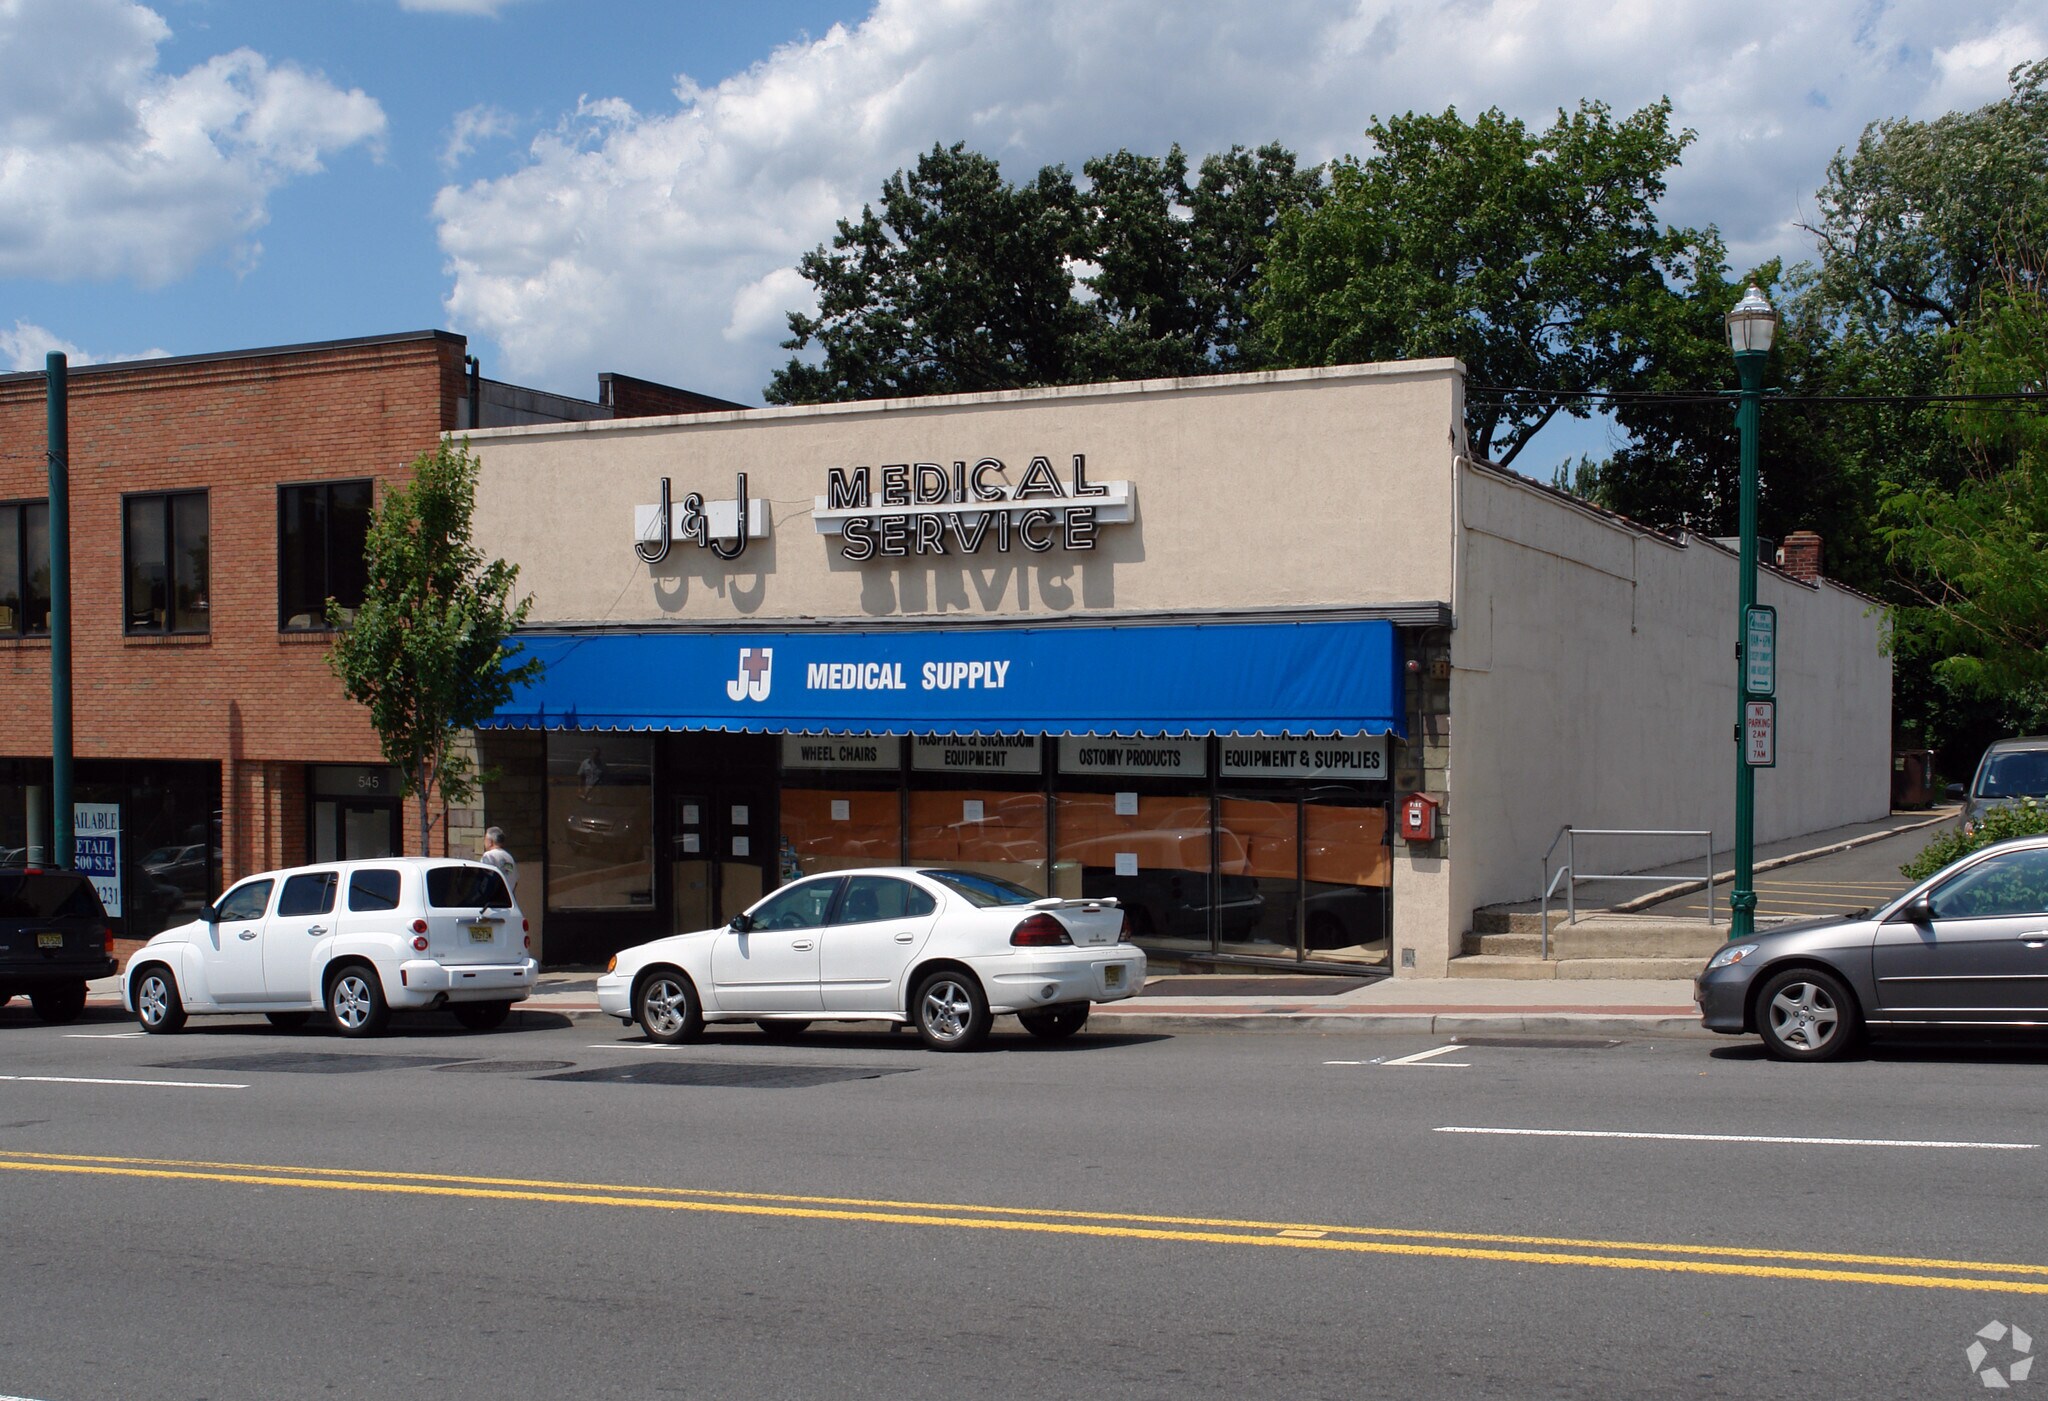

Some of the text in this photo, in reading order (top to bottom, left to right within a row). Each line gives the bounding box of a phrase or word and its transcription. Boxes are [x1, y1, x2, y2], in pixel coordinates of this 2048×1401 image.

[828, 454, 1109, 509] MEDICAL
[635, 472, 748, 564] J&J
[841, 506, 1098, 561] SERVICE
[807, 660, 1010, 690] MEDICAL SUPPLY
[1755, 706, 1764, 716] NO
[1748, 718, 1771, 728] PARKING
[1752, 730, 1766, 739] 2AM
[1756, 740, 1764, 748] TO
[801, 746, 877, 761] WHEEL CHAIRS
[945, 750, 1007, 766] EQUIPMENT
[1079, 748, 1181, 767] OSTOMY PRODUCTS
[1225, 750, 1380, 769] EQUIPMENT & SUPPLIES
[1753, 750, 1766, 759] 7AM
[359, 776, 379, 788] 545
[75, 812, 117, 830] AILABLE
[76, 840, 112, 855] ETAIL
[74, 856, 115, 871] 500 S.F.
